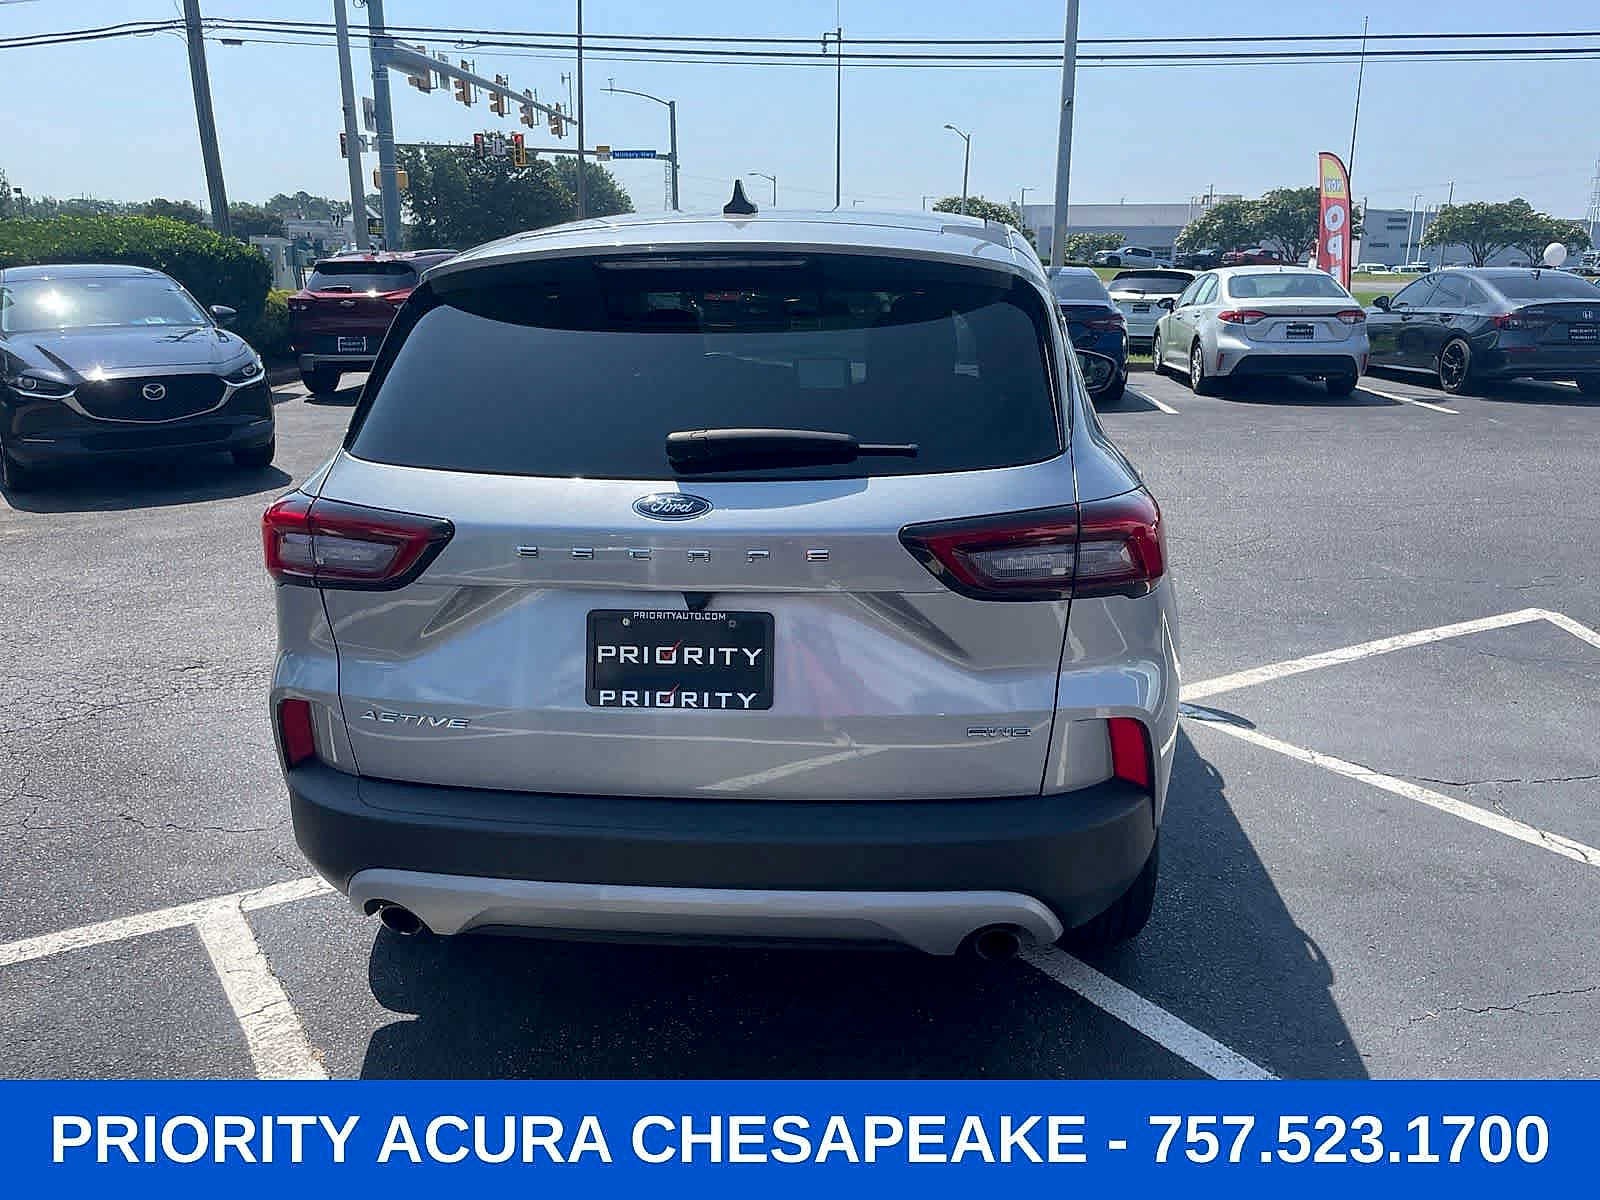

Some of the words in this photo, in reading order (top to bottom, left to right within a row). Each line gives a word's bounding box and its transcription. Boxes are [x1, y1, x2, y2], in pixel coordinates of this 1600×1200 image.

[650, 497, 695, 513] Ford
[516, 545, 830, 562] ESCAPE
[633, 611, 727, 621] PRIORITYAUTO.COM
[597, 644, 762, 666] PRIORITY
[600, 689, 757, 709] PRIORITY
[360, 710, 470, 729] ACTIVE
